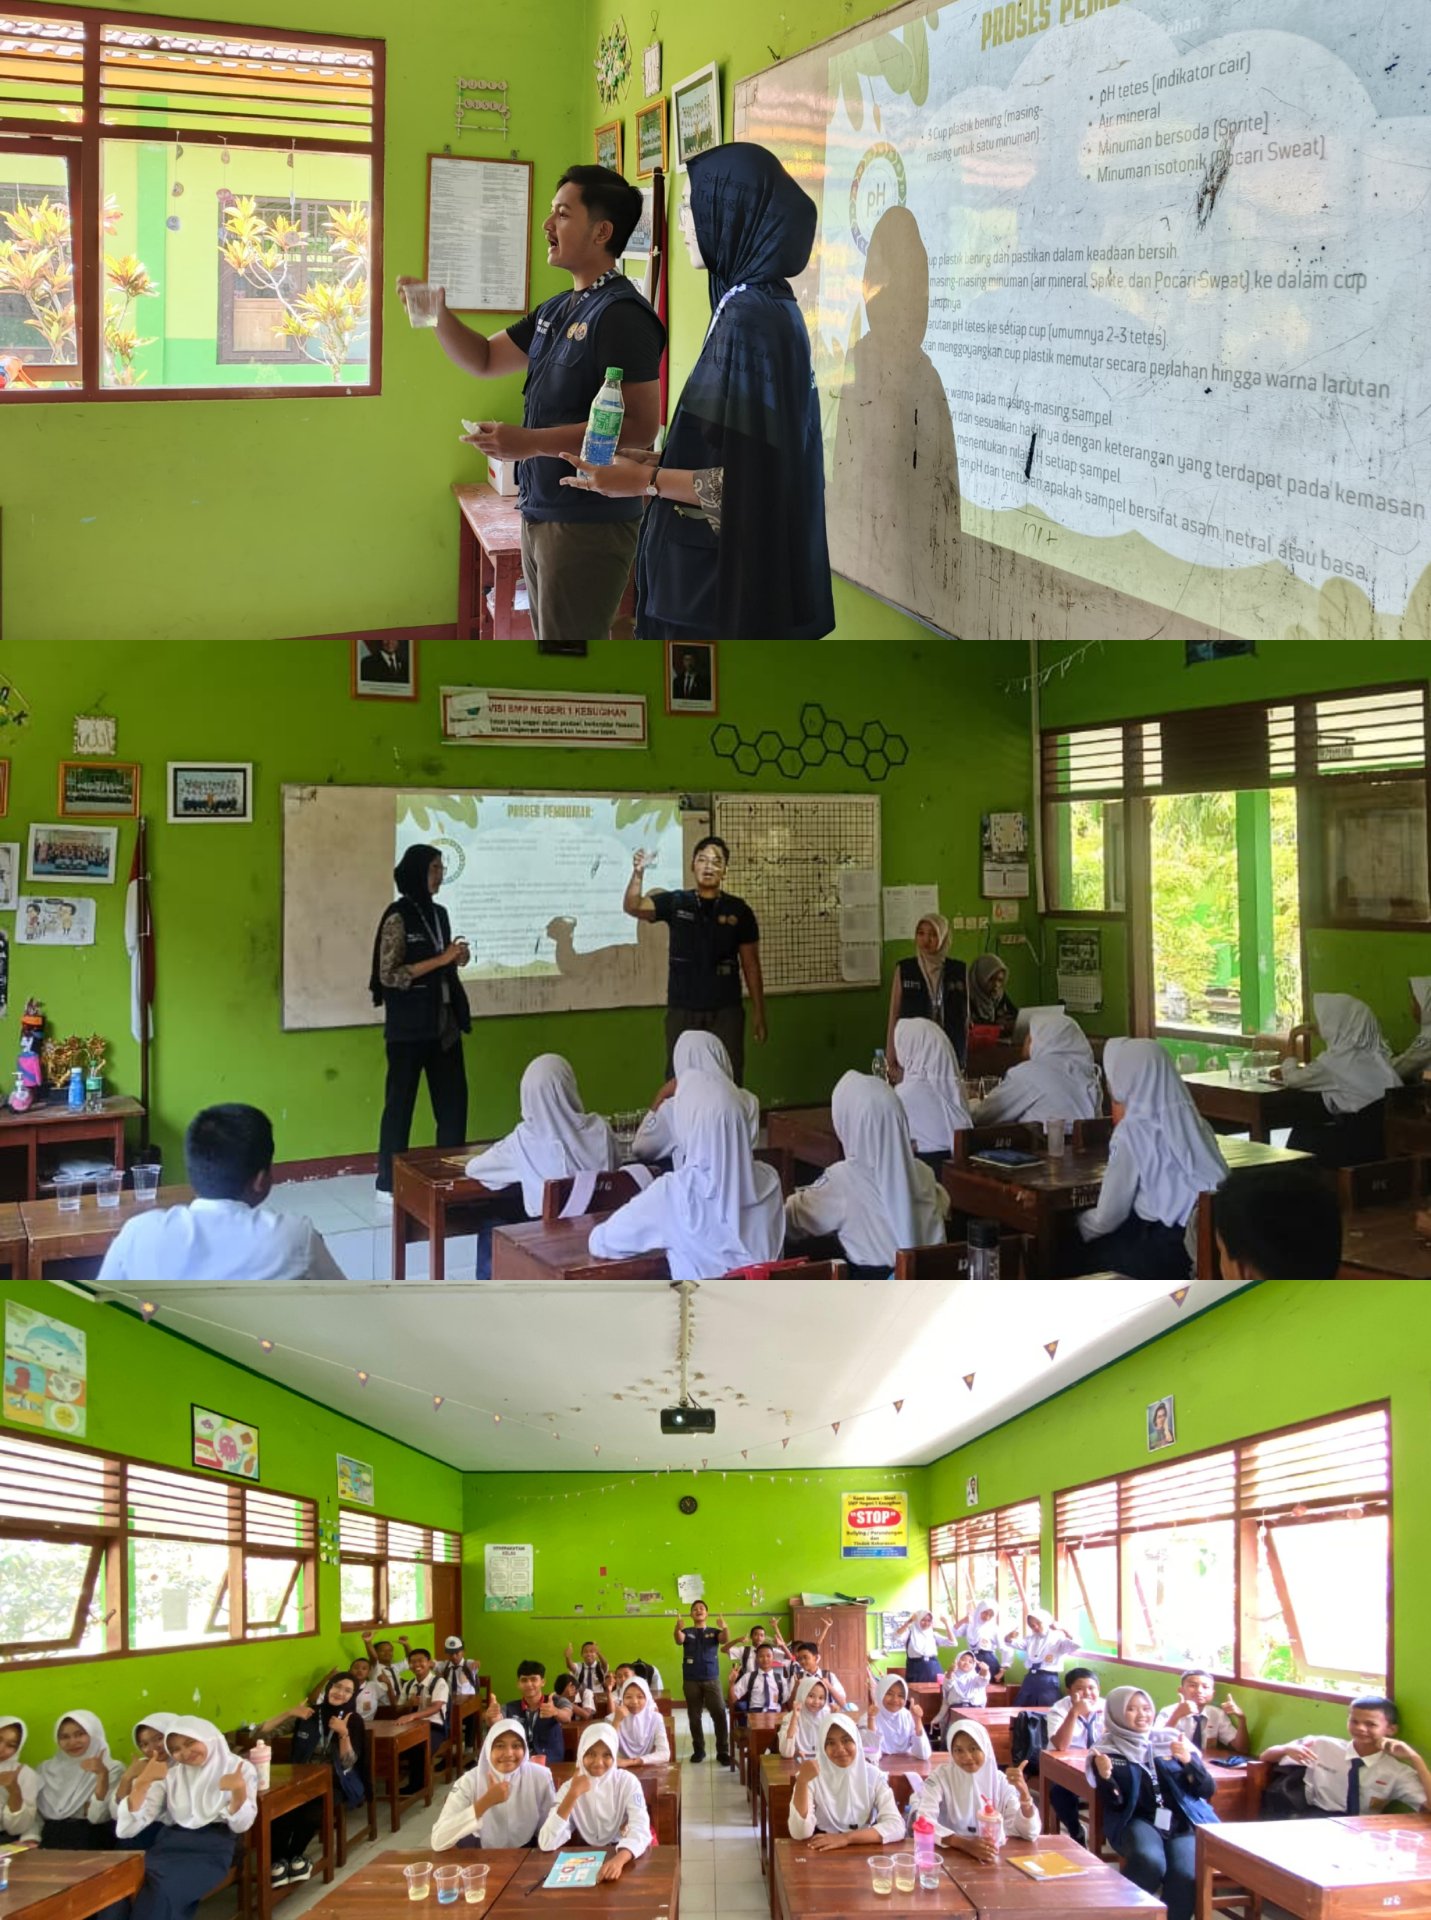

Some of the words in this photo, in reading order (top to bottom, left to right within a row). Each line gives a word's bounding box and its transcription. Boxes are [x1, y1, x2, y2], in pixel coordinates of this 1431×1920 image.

[981, 0, 1051, 51] PROSES
[1099, 83, 1115, 106] pH
[1117, 81, 1149, 98] tetes
[1151, 63, 1216, 96] (indikator
[1219, 51, 1251, 75] cair)
[933, 125, 948, 141] Cup
[948, 119, 973, 140] plastik
[974, 115, 1002, 130] bening
[1098, 112, 1115, 129] Air
[1116, 102, 1161, 123] mineral
[926, 147, 951, 163] masing
[953, 142, 975, 157] untuk
[976, 138, 994, 153] satu
[1098, 133, 1152, 156] Minuman
[1155, 122, 1210, 147] bersoda
[1097, 163, 1150, 184] Minuman
[1154, 153, 1207, 177] isotonik
[867, 182, 886, 218] pH
[938, 252, 963, 269] plastik
[964, 251, 991, 268] bening
[993, 250, 1010, 264] dan
[1011, 248, 1050, 267] pastikan
[1053, 246, 1084, 262] dalam
[1086, 244, 1135, 261] keadaan
[929, 275, 986, 291] masing-masing
[988, 275, 1029, 288] minuman
[1030, 273, 1046, 291] (air
[1128, 271, 1151, 288] dan
[1155, 271, 1194, 288] Pocari
[1254, 269, 1273, 289] ke
[1277, 269, 1328, 289] dalam
[1333, 272, 1367, 294] cup
[952, 321, 964, 333] pH
[964, 321, 986, 333] tetes
[987, 322, 998, 334] ke
[999, 322, 1027, 340] setiap
[1028, 325, 1046, 340] cup
[1048, 323, 1104, 346] (umumnya
[1106, 326, 1127, 343] 2-3
[937, 341, 1002, 360] menggoyangkan
[1004, 347, 1021, 362] cup
[1022, 348, 1054, 364] plastik
[1056, 354, 1104, 369] memutar
[1106, 359, 1147, 374] secara
[1149, 360, 1208, 380] perlahan
[1211, 363, 1261, 390] hingga
[1265, 373, 1317, 392] warna
[1322, 373, 1390, 399] larutan
[950, 389, 974, 401] warna
[975, 391, 996, 407] pada
[957, 433, 1008, 456] menentukan
[1045, 451, 1077, 474] setiap
[958, 409, 973, 423] dan
[974, 415, 1017, 434] sesuaikan
[1062, 430, 1102, 453] dengan
[1104, 436, 1174, 468] keterangan
[1177, 455, 1212, 480] yang
[1215, 459, 1282, 491] terdapat
[1286, 474, 1330, 500] pada
[1335, 482, 1425, 520] kemasan
[970, 458, 983, 474] pH
[984, 462, 1000, 477] dan
[1044, 480, 1082, 501] apakah
[1085, 489, 1127, 513] sampel
[1128, 498, 1179, 529] bersifat
[1278, 540, 1316, 567] atau
[530, 705, 565, 716] NEGERI
